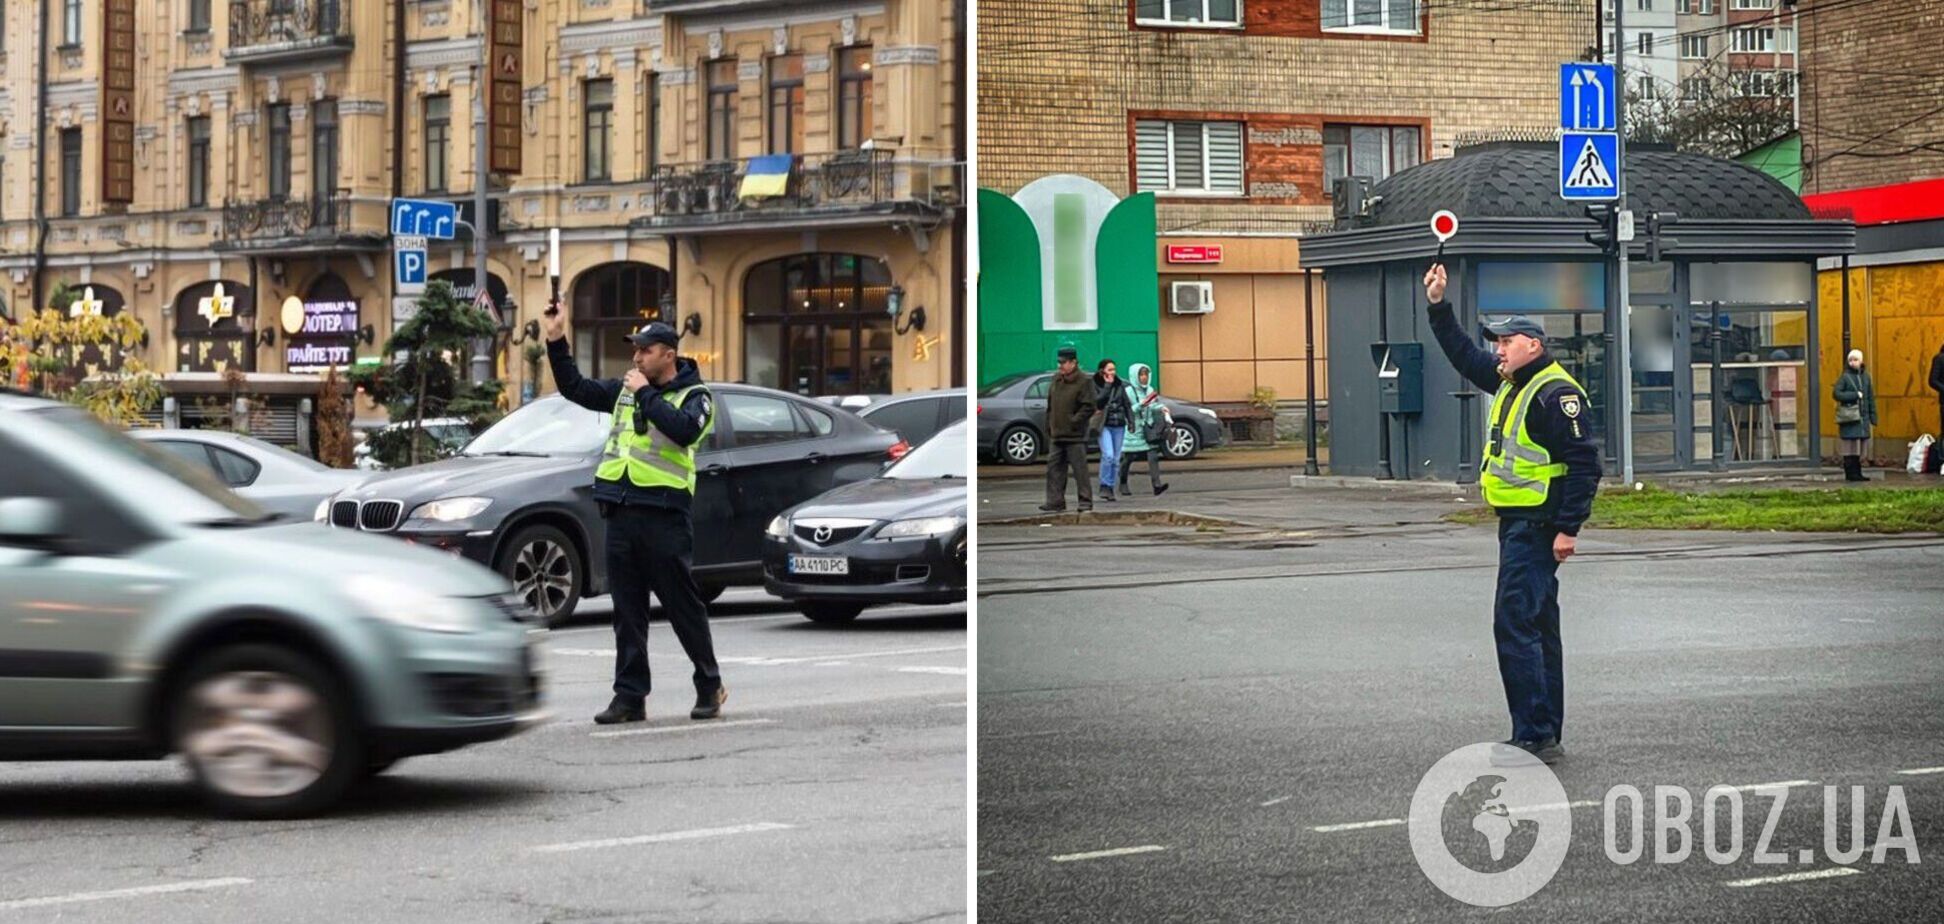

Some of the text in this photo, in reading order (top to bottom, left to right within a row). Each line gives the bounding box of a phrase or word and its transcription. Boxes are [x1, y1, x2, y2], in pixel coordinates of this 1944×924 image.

[396, 238, 427, 249] ЗОНА
[405, 253, 420, 282] P
[302, 313, 357, 331] ЛОТЕР
[287, 343, 351, 363] ГРАЙТЕ ТУТ
[795, 558, 806, 571] AA
[807, 559, 829, 571] 4110
